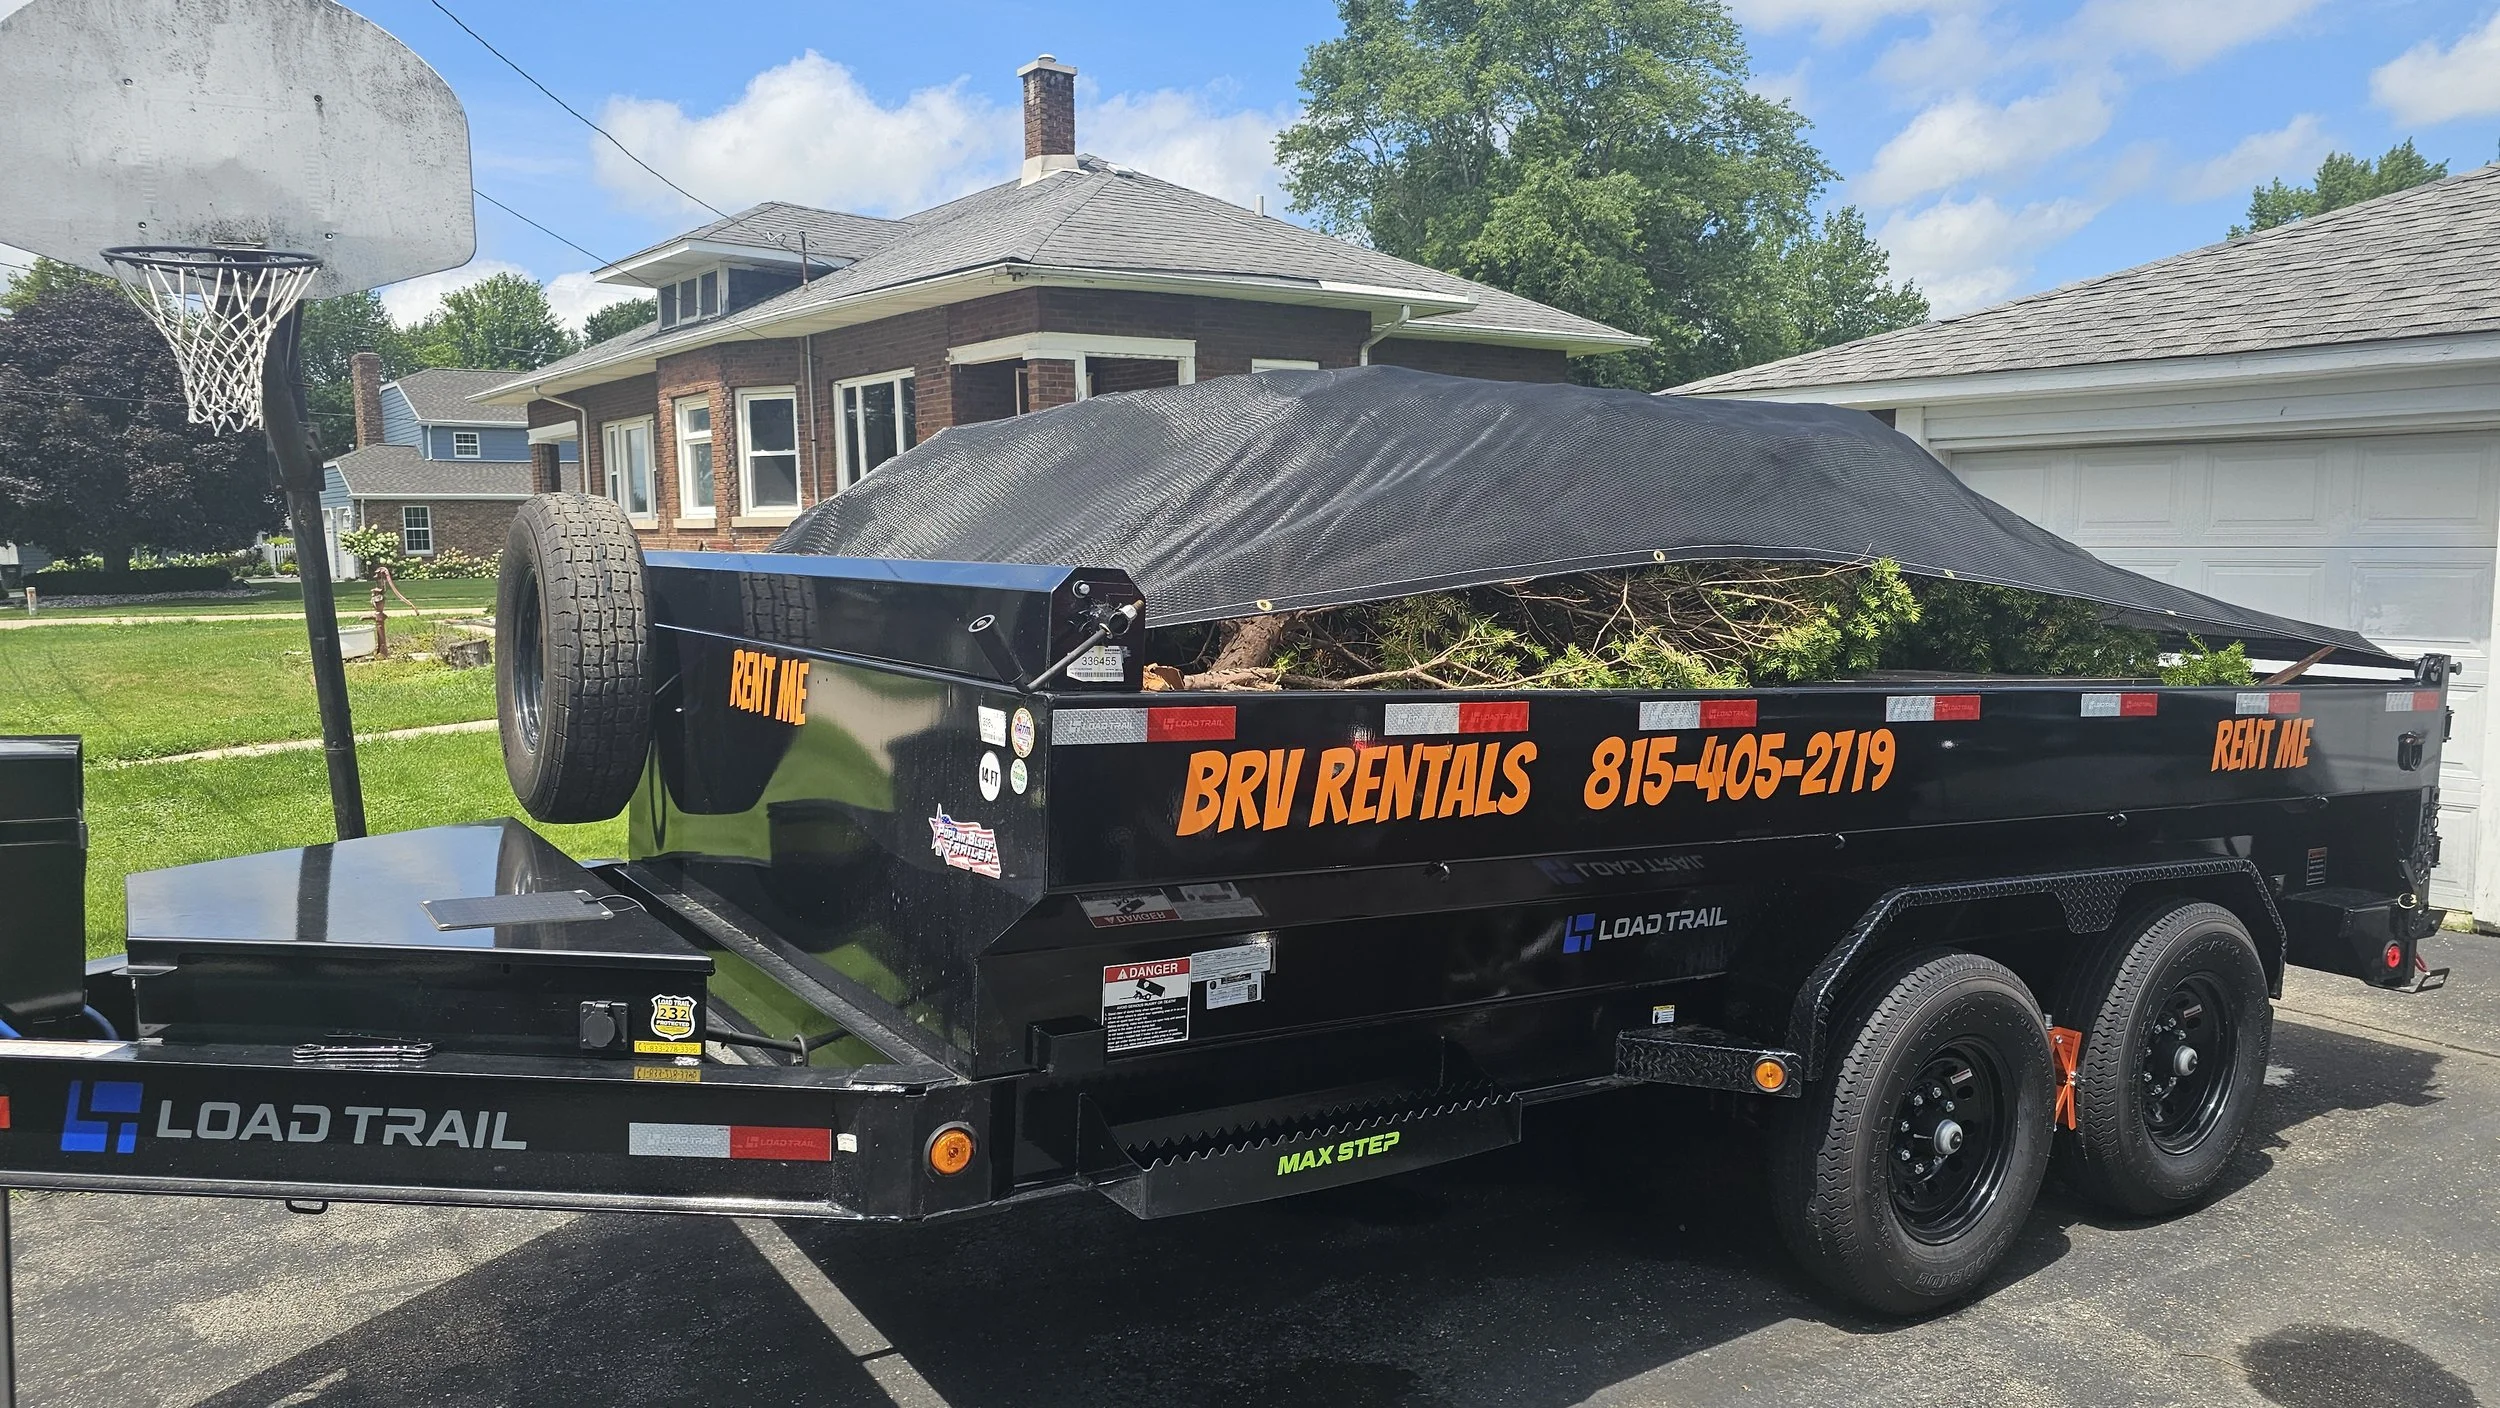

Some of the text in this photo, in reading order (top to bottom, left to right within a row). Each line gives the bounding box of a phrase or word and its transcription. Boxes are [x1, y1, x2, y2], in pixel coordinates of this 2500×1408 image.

[1082, 656, 1116, 666] 336455
[729, 649, 809, 725] RENT ME
[1112, 722, 1135, 730] TRAIL
[2210, 718, 2314, 772] RENT ME
[982, 766, 988, 783] 14
[990, 770, 998, 787] FT
[1584, 728, 1896, 811] 815-405-2719
[1176, 741, 1538, 836] BRV RENTALS
[937, 825, 995, 850] POPLAR BLUFF
[1598, 906, 1728, 940] LOAD TRAIL
[1129, 963, 1178, 978] DANGER
[156, 1100, 527, 1150] LOAD TRAIL
[661, 1136, 720, 1146] LOAD TRAIL
[760, 1139, 815, 1148] LOAD TRAIL
[1276, 1131, 1400, 1176] MAX STEP
